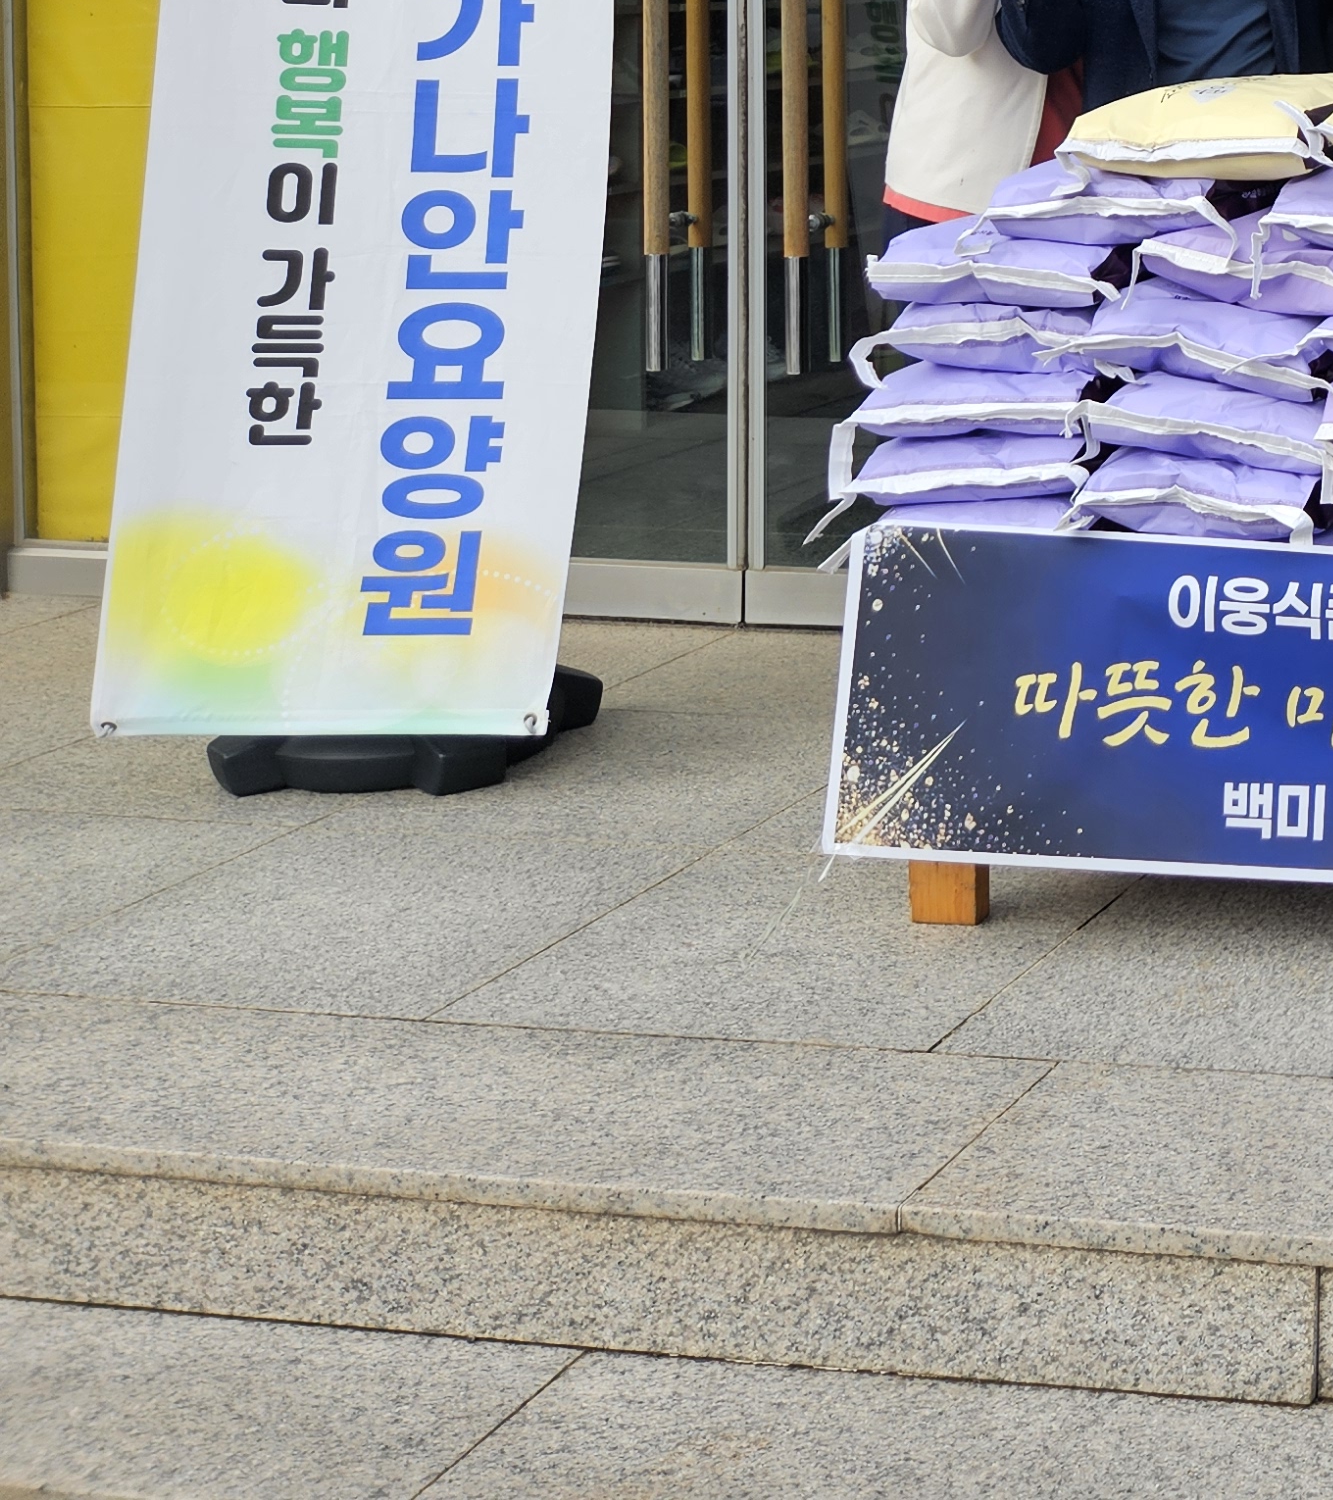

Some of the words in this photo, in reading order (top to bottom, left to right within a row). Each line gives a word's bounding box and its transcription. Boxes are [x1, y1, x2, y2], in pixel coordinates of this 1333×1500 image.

[265, 28, 349, 225] 행복이
[246, 248, 336, 446] 가득한
[1013, 659, 1262, 749] 따뜻한
[1223, 781, 1327, 843] 백미
